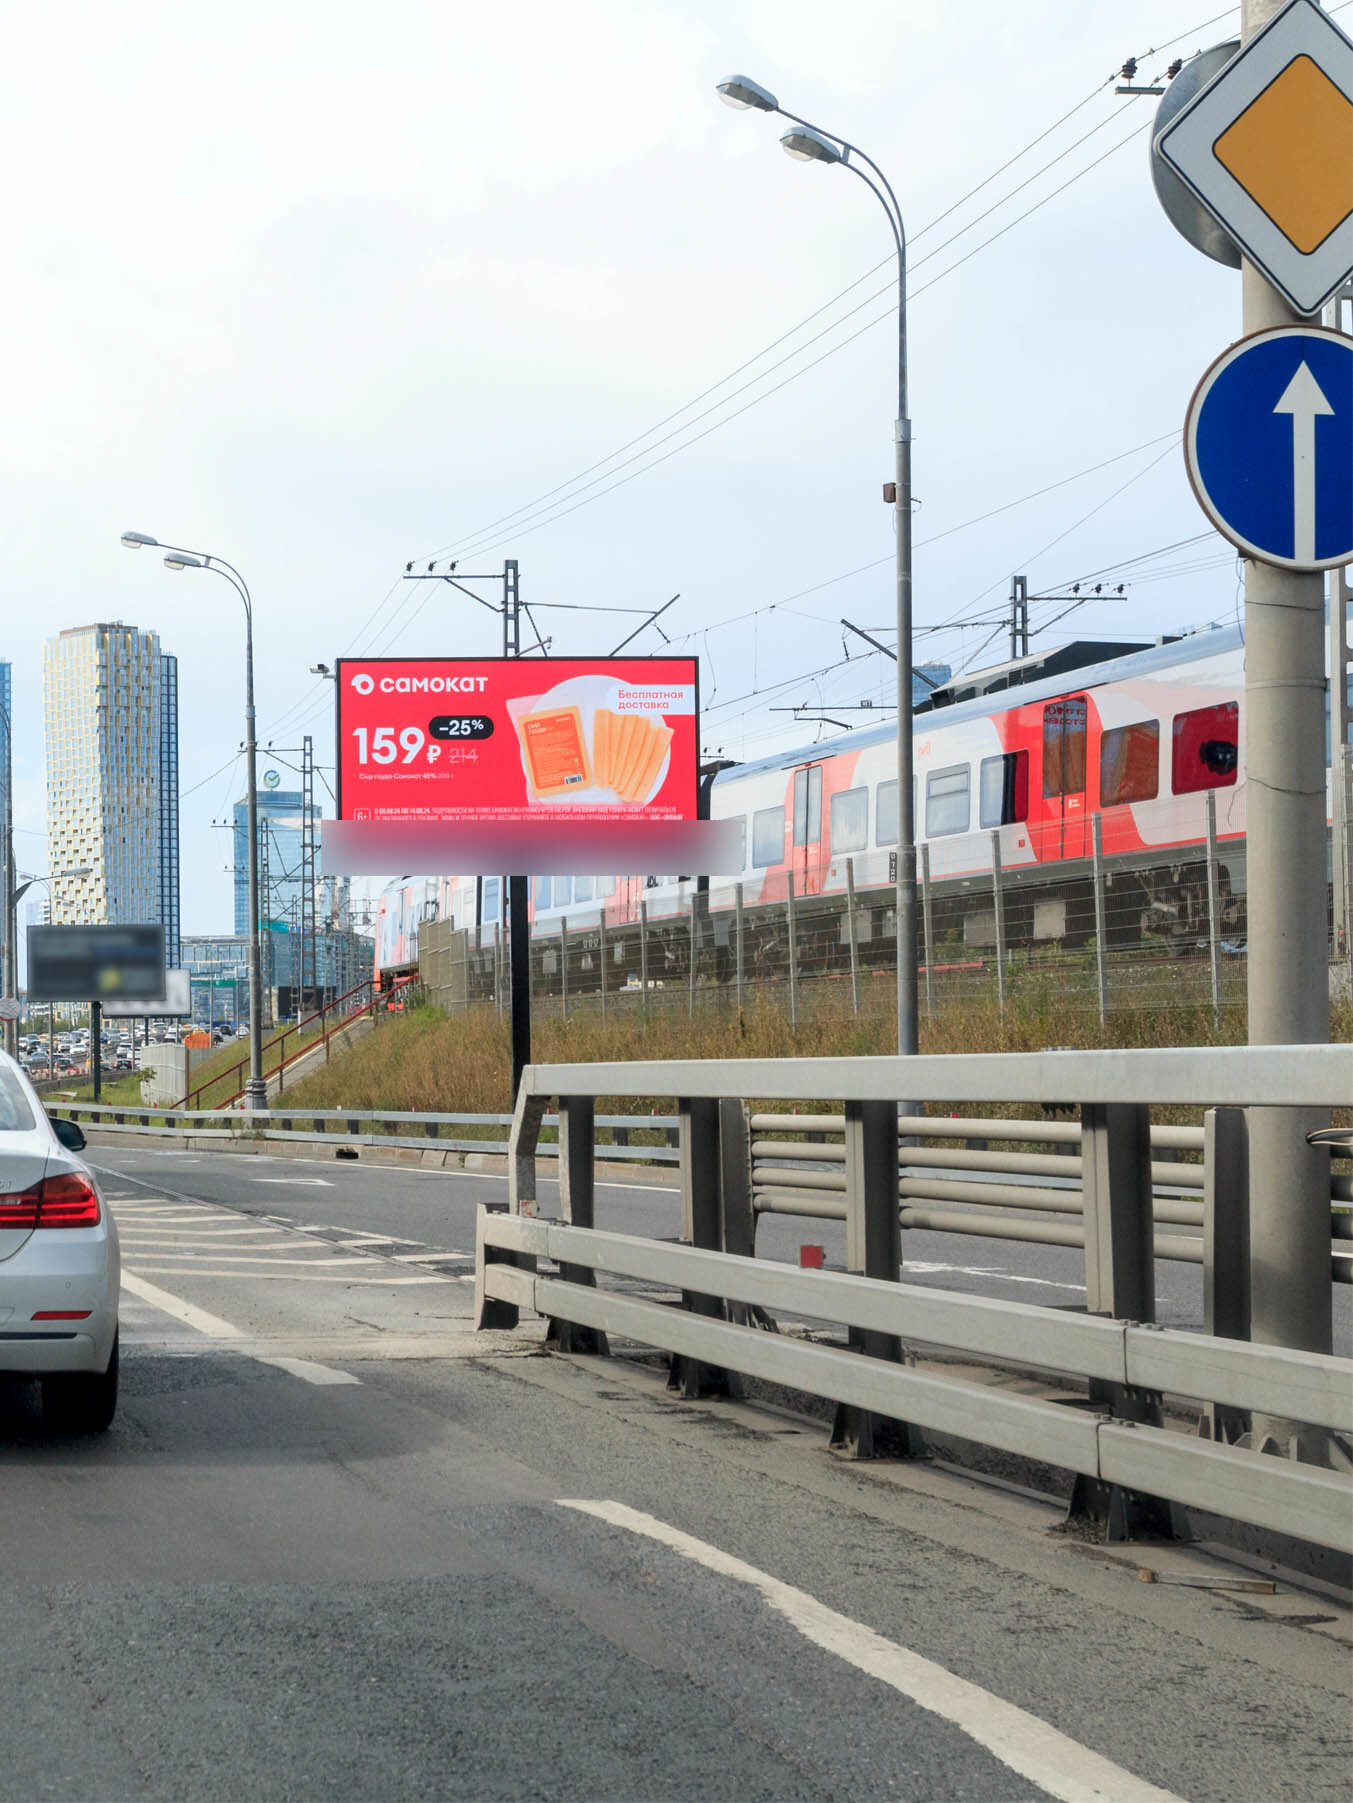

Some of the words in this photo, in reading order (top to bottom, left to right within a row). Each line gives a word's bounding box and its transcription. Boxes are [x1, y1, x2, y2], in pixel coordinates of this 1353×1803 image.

[379, 676, 489, 693] самокат
[618, 689, 684, 699] Бесплатная
[618, 701, 669, 710] доставка
[439, 719, 485, 735] -25%
